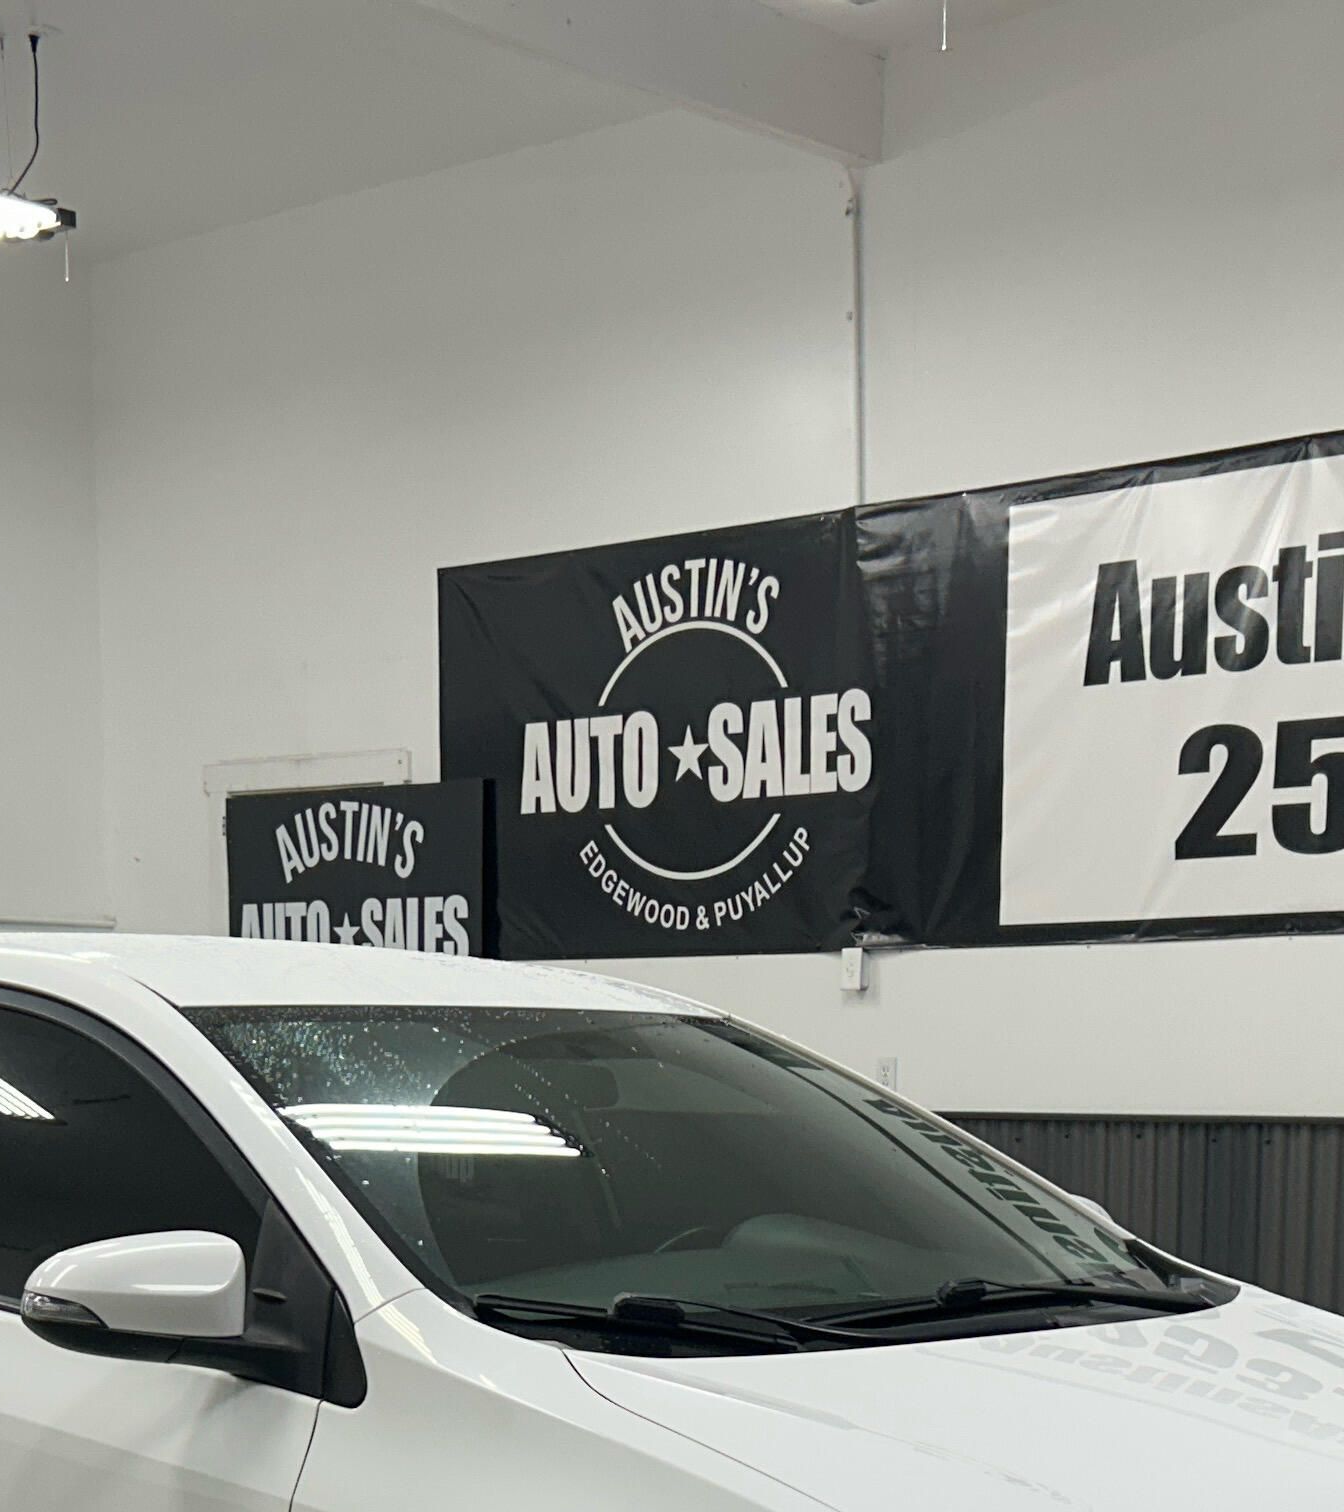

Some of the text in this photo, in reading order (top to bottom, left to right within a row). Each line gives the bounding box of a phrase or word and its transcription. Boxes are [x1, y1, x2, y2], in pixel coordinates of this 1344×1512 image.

[611, 557, 781, 654] AUSTIN'S
[519, 687, 873, 815] AUTO SALES
[274, 800, 425, 884] AUSTIN'S
[579, 826, 811, 931] EDGEWOOD & PUYALLUP
[360, 894, 470, 957] SALES
